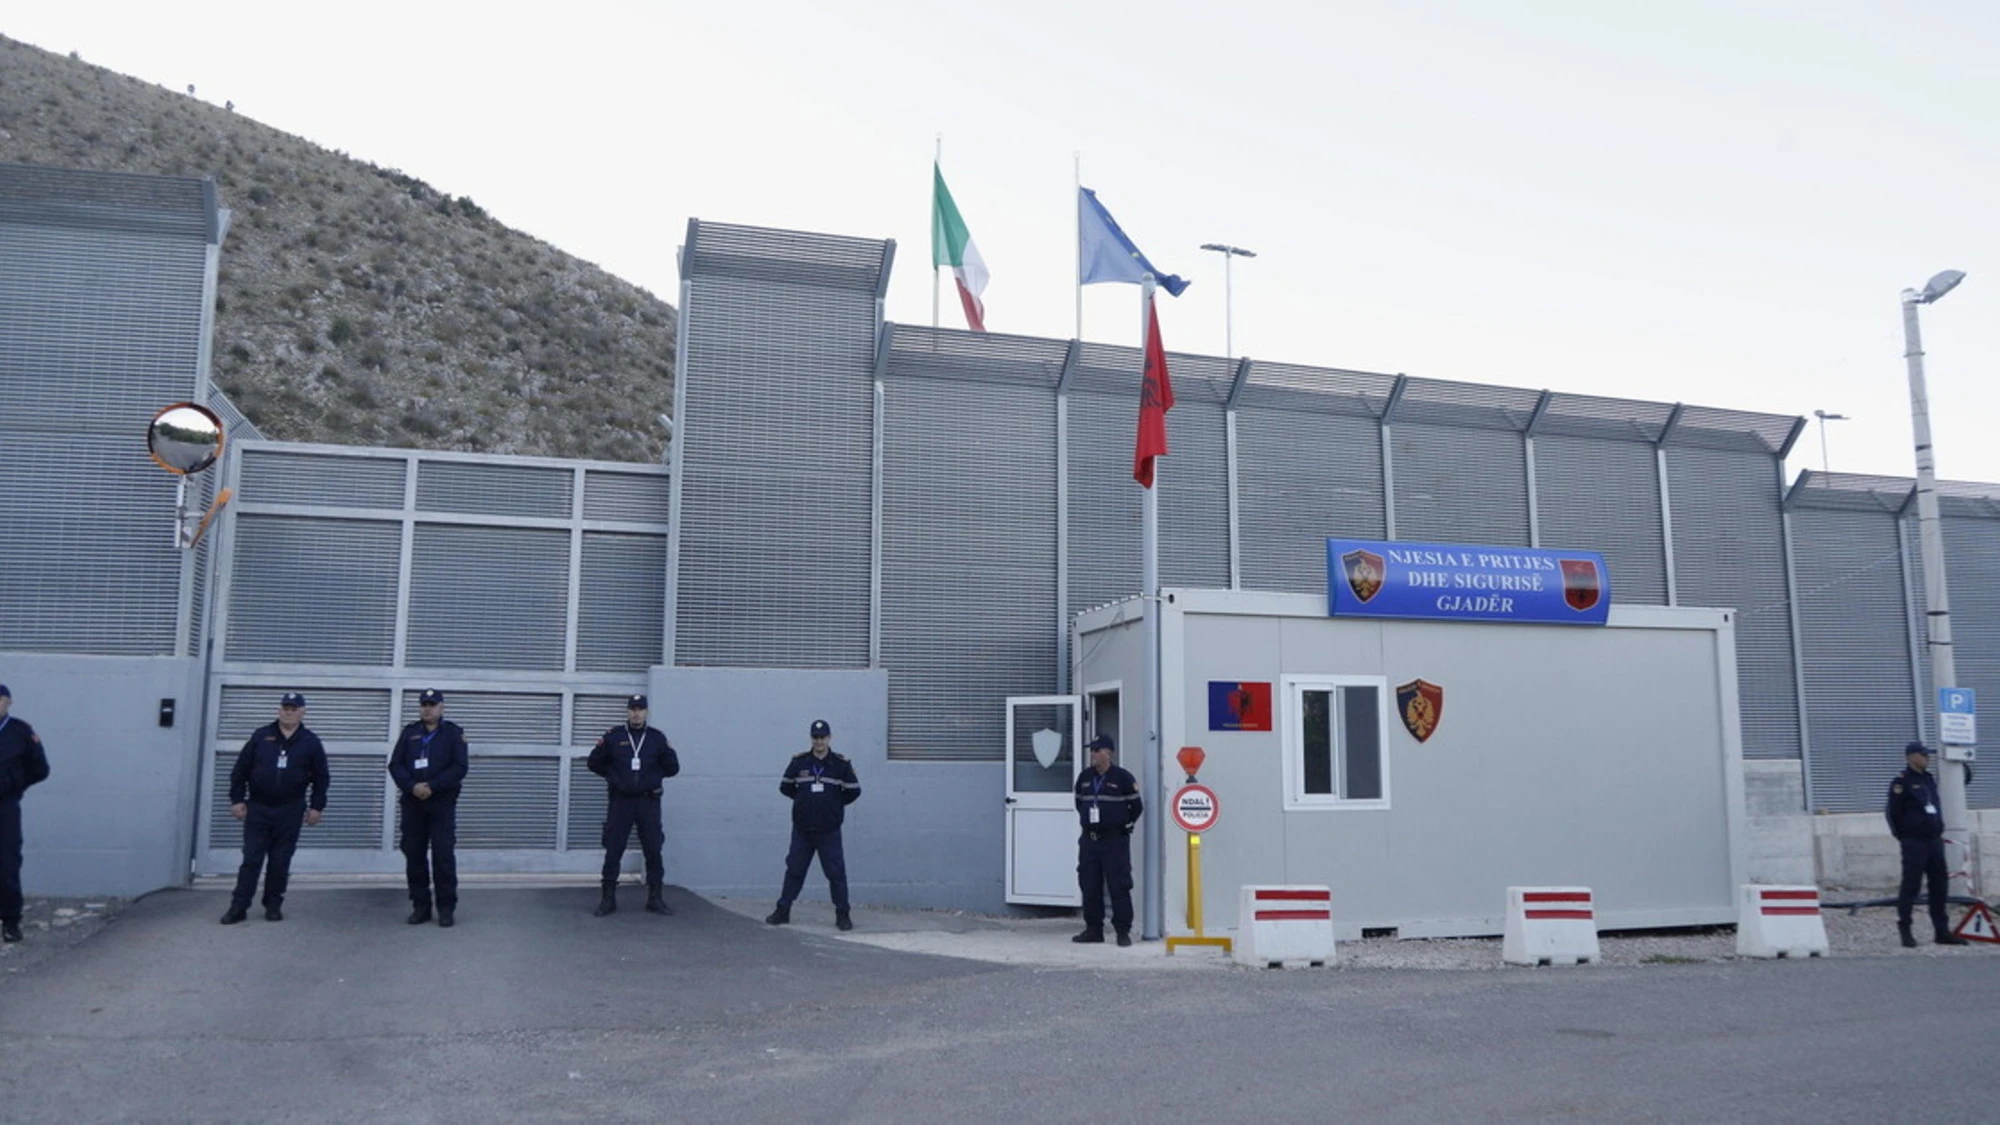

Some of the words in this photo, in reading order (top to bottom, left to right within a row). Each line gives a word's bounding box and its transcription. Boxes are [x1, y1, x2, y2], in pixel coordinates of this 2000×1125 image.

[1389, 550, 1456, 567] NJESIA
[1462, 553, 1475, 567] E
[1479, 554, 1555, 571] PRITJES
[1408, 571, 1450, 588] DHE
[1455, 572, 1544, 592] SIGURISË
[1436, 593, 1514, 613] GJADËR
[1951, 693, 1963, 708] P
